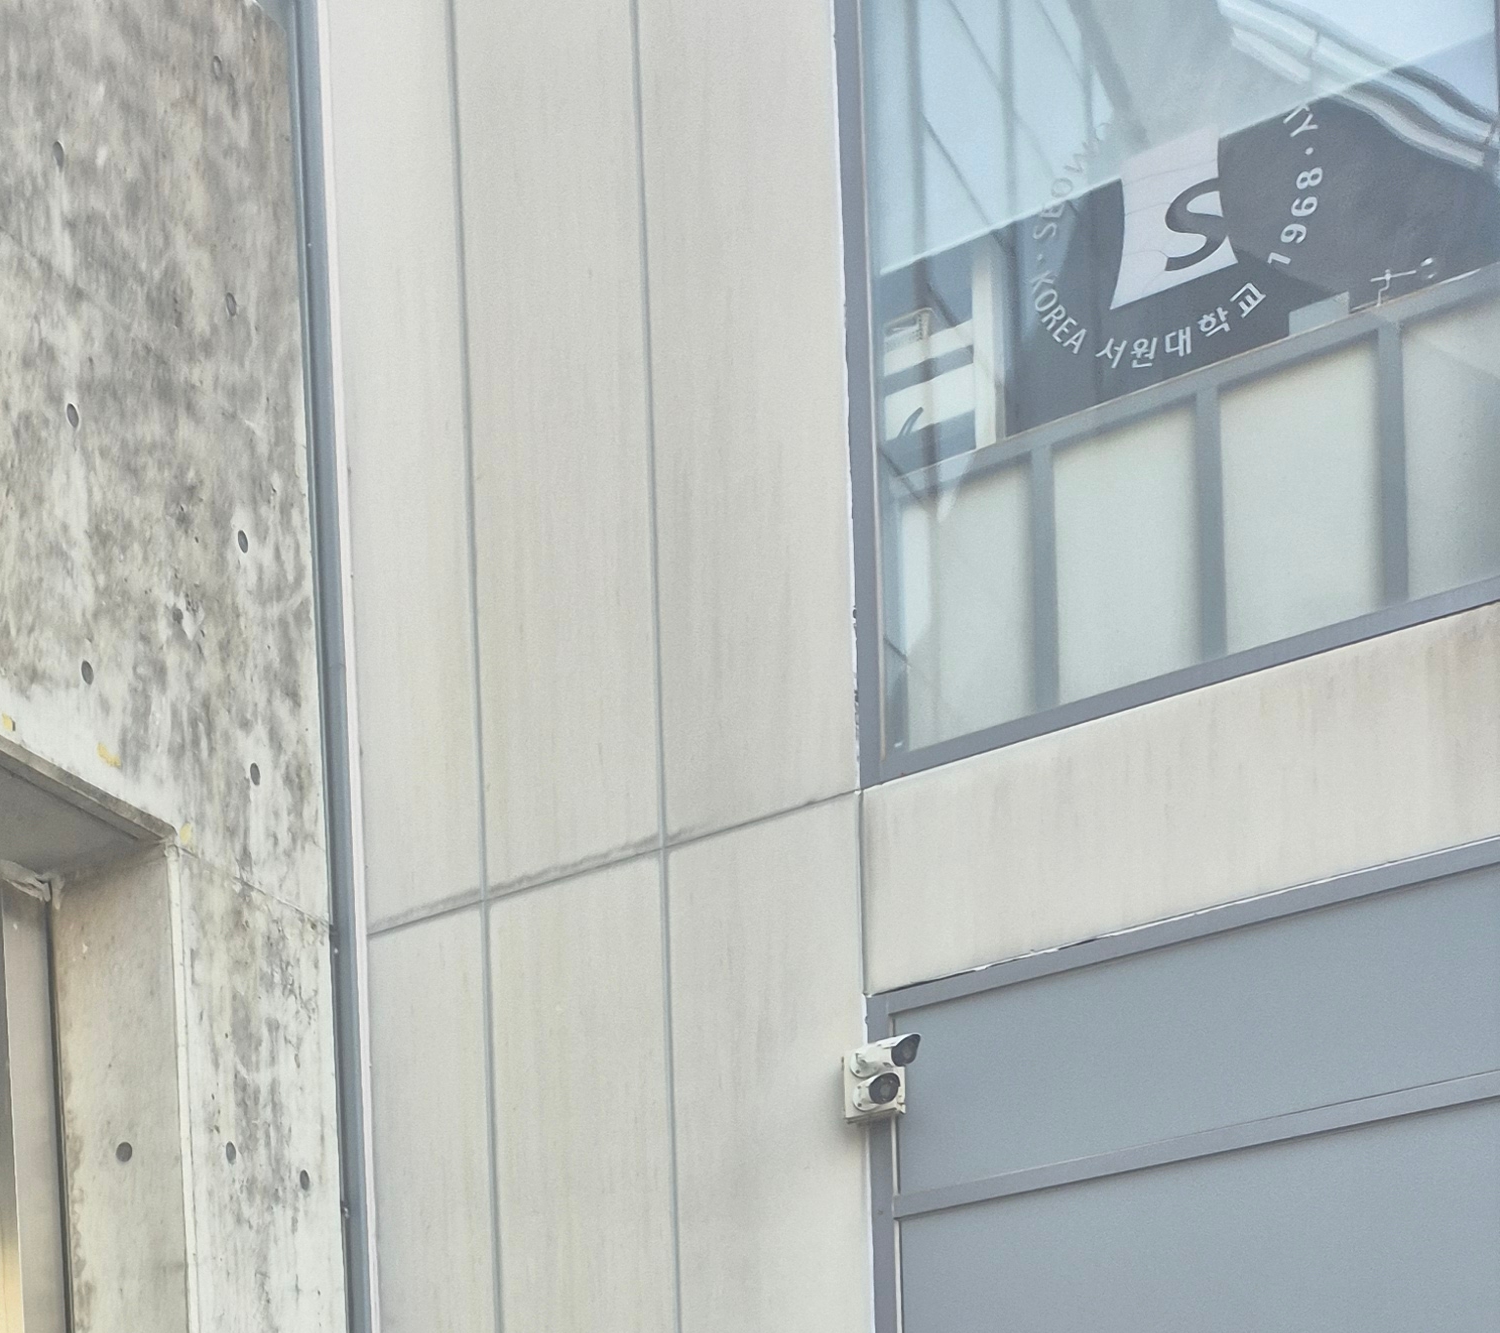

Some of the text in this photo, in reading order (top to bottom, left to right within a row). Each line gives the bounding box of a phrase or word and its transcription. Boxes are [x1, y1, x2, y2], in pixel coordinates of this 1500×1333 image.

[1267, 166, 1324, 267] 1968
[1030, 270, 1090, 355] KOREA
[1095, 282, 1267, 369] 서원대학교
